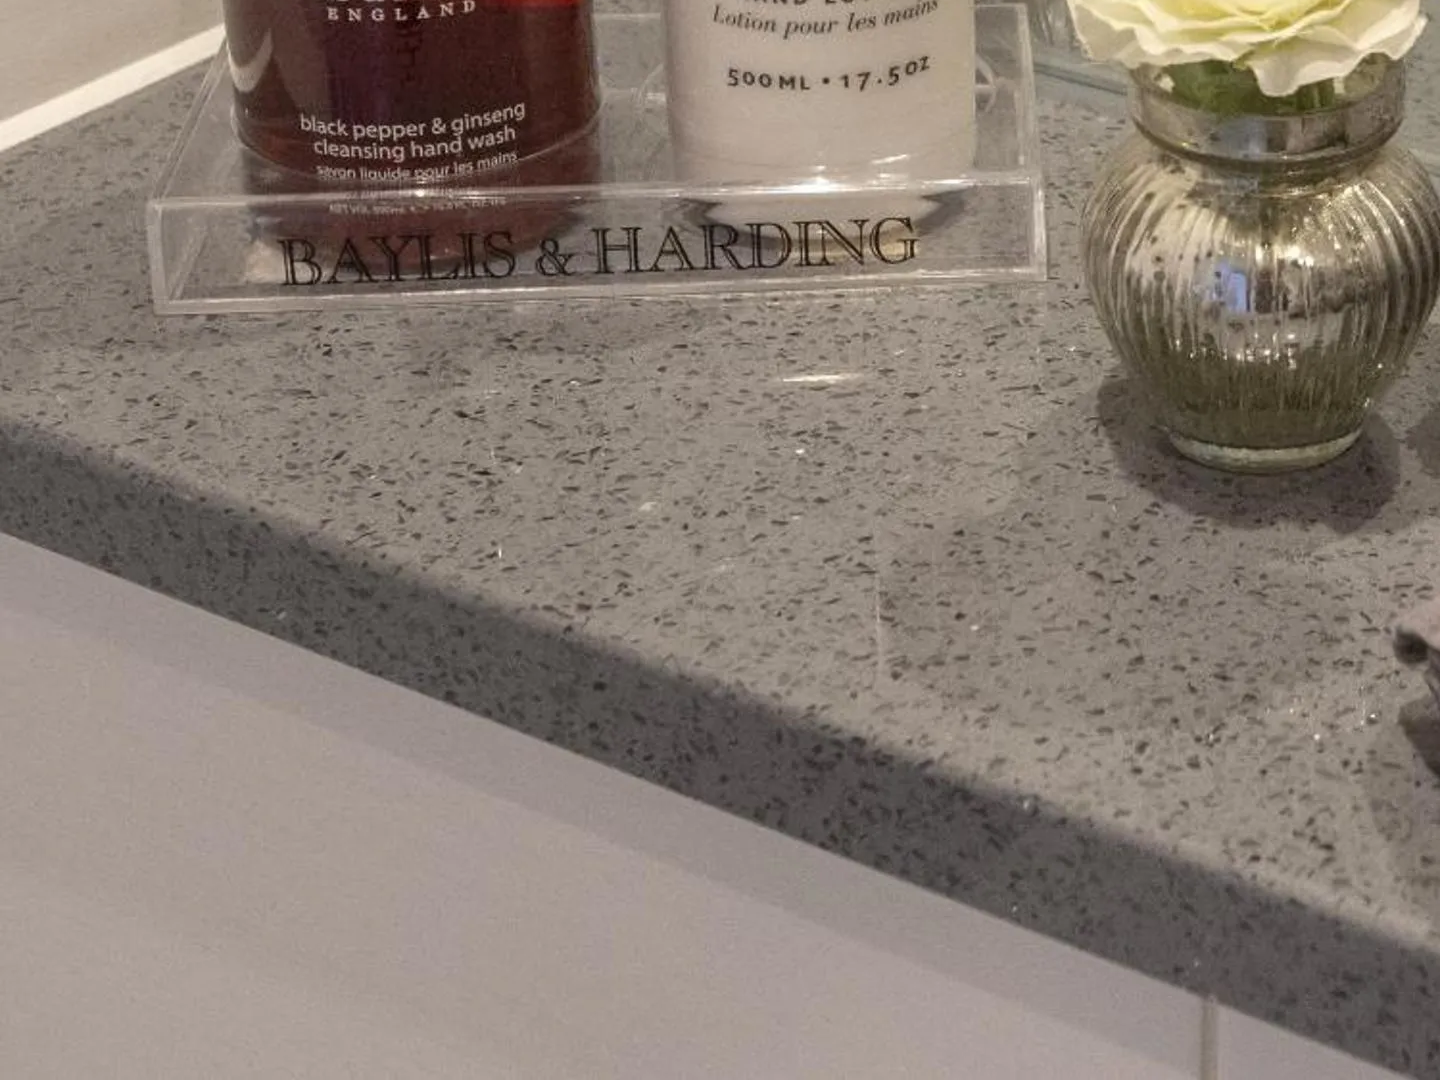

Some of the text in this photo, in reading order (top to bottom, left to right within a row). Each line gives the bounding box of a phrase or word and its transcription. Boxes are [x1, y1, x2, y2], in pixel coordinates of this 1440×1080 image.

[327, 0, 477, 22] ENGLAND
[712, 4, 777, 34] Lotion
[783, 19, 839, 40] pour
[848, 11, 877, 33] les
[726, 68, 811, 92] 500ML
[300, 102, 526, 142] black pepper & ginseng
[313, 126, 516, 163] cleansing hand wash
[477, 151, 518, 171] mains
[276, 216, 922, 286] BAYLIS & HARDING
